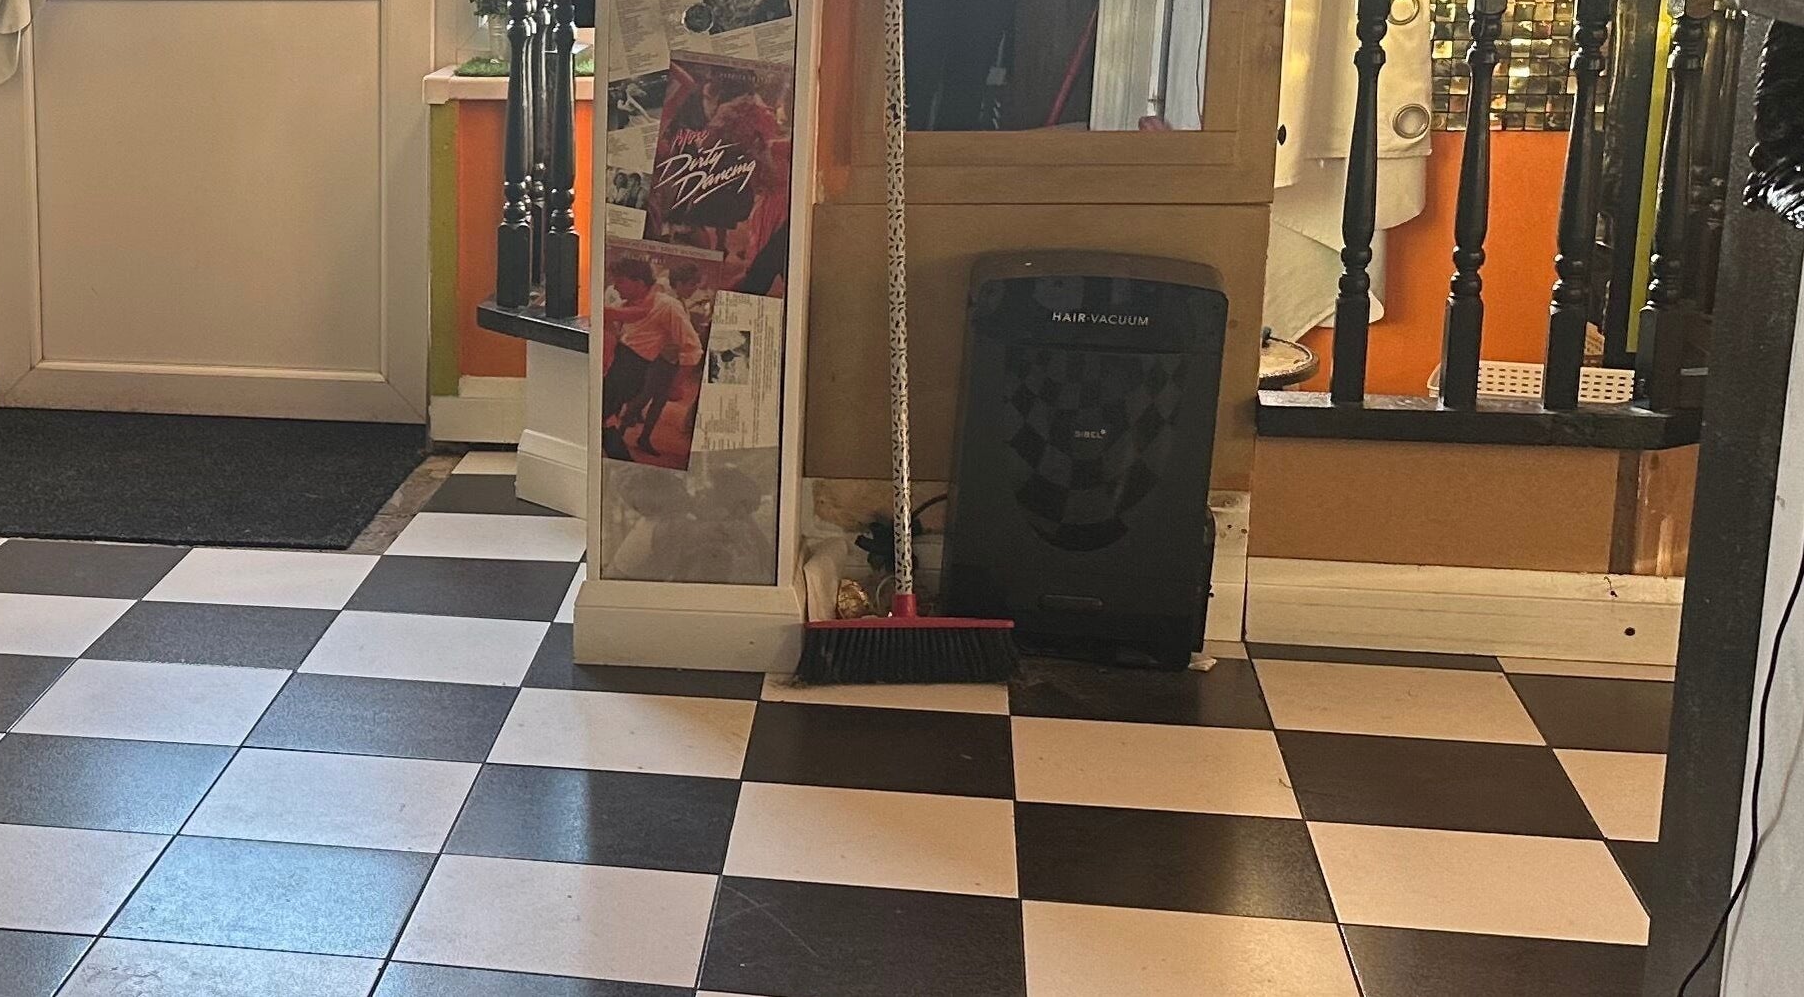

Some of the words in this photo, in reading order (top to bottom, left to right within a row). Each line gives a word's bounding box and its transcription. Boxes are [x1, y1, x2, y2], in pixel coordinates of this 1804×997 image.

[653, 139, 740, 189] Dirty
[670, 155, 756, 210] Dancing
[1090, 313, 1149, 326] VACUUM
